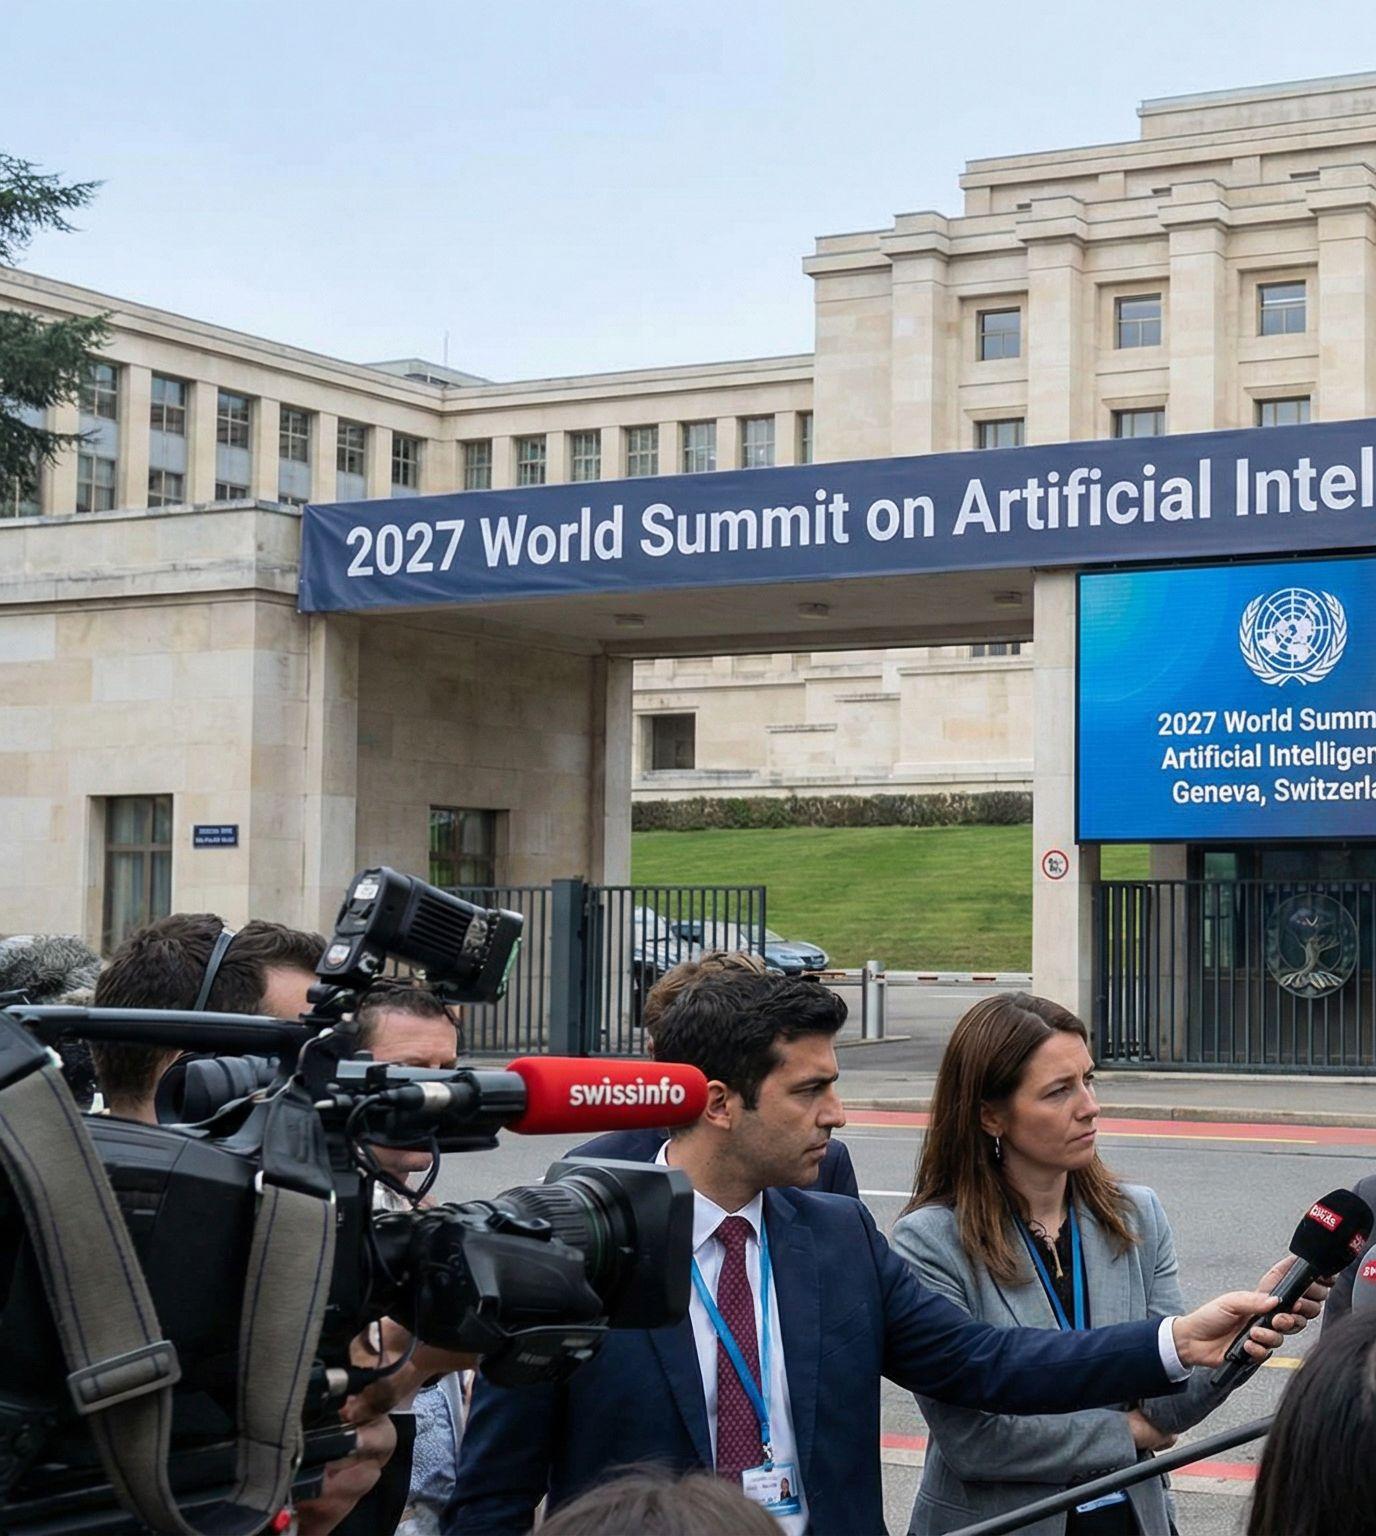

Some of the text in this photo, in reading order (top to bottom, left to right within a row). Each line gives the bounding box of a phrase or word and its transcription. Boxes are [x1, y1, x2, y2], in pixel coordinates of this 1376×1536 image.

[346, 519, 465, 577] 2027
[479, 504, 624, 567] World
[640, 488, 849, 557] Summit
[866, 496, 935, 541] on
[952, 458, 1211, 535] Artificial
[1158, 711, 1217, 736] 2027
[1224, 707, 1292, 733] World
[1161, 743, 1261, 769] Artificial
[1172, 780, 1266, 807] Geneva,
[569, 1076, 686, 1106] swissinfo
